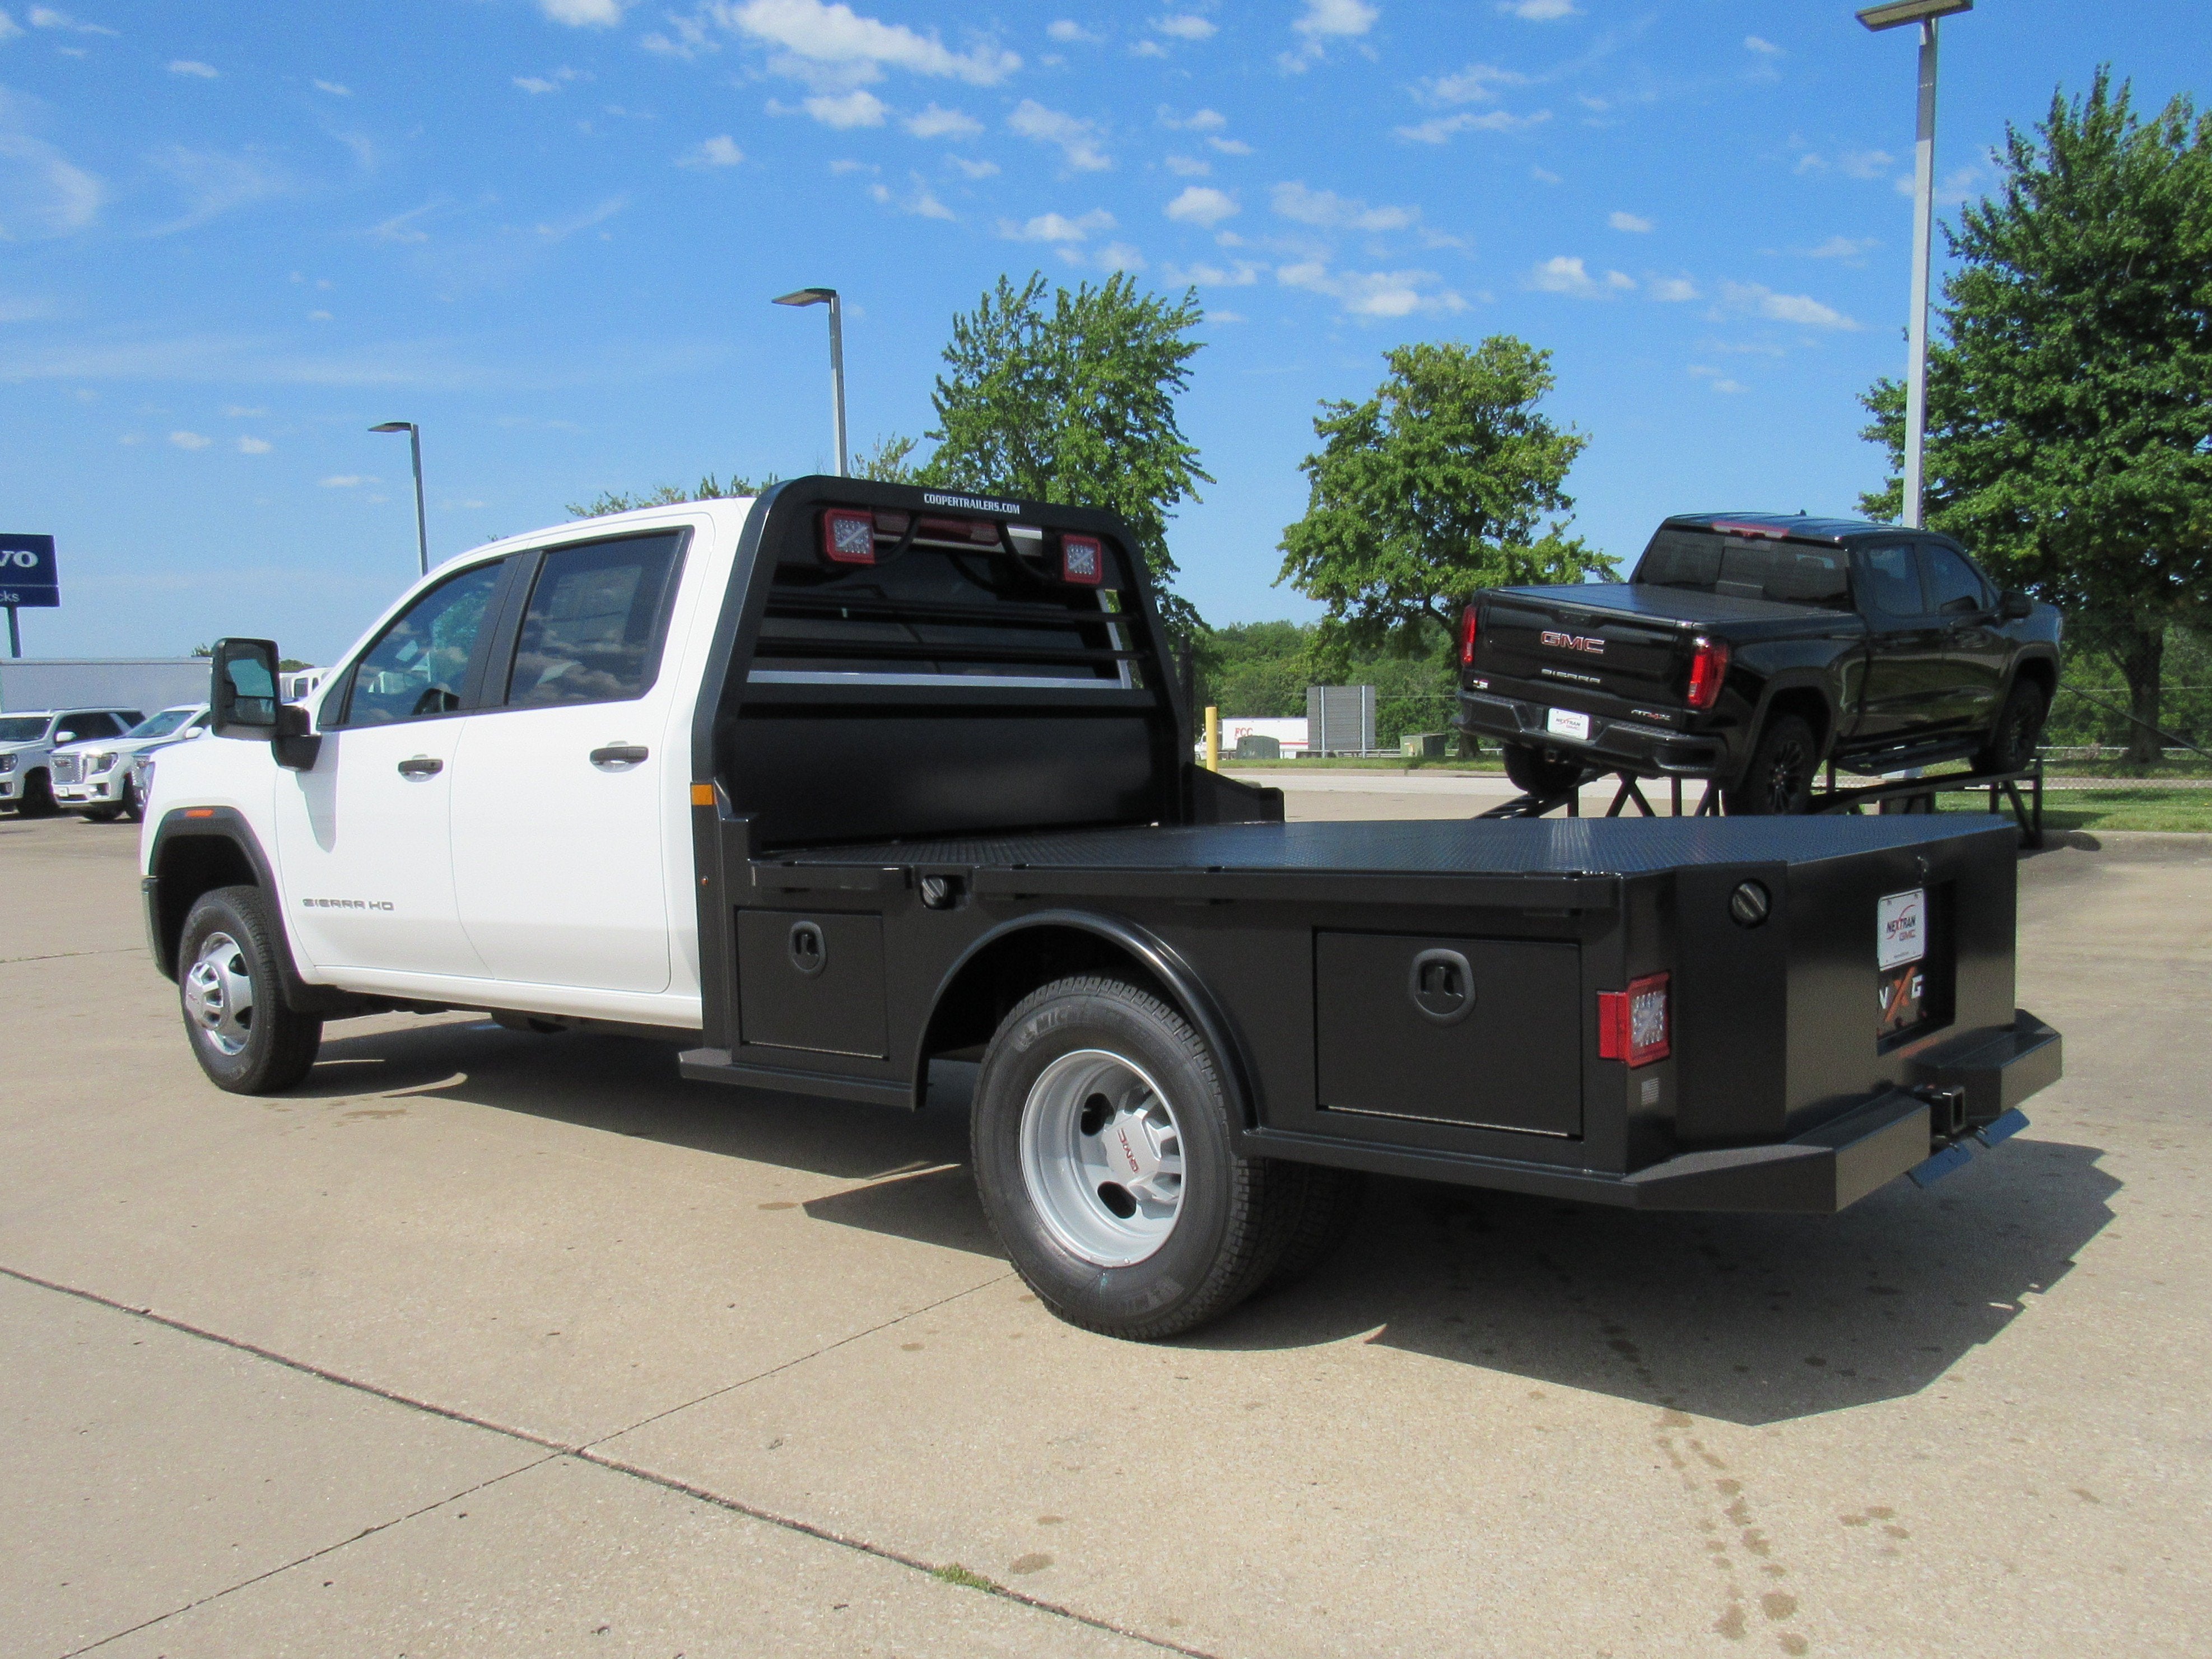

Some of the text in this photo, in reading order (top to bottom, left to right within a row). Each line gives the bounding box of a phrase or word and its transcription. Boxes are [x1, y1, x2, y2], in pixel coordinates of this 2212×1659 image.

[924, 493, 1020, 514] COOPERTRAILERS.COM
[1540, 631, 1605, 654] GMC
[1541, 669, 1601, 683] SIERRA
[302, 898, 395, 911] SIERRA HD
[1887, 915, 1916, 933] NEXTRAN
[1116, 1127, 1139, 1173] GMC
